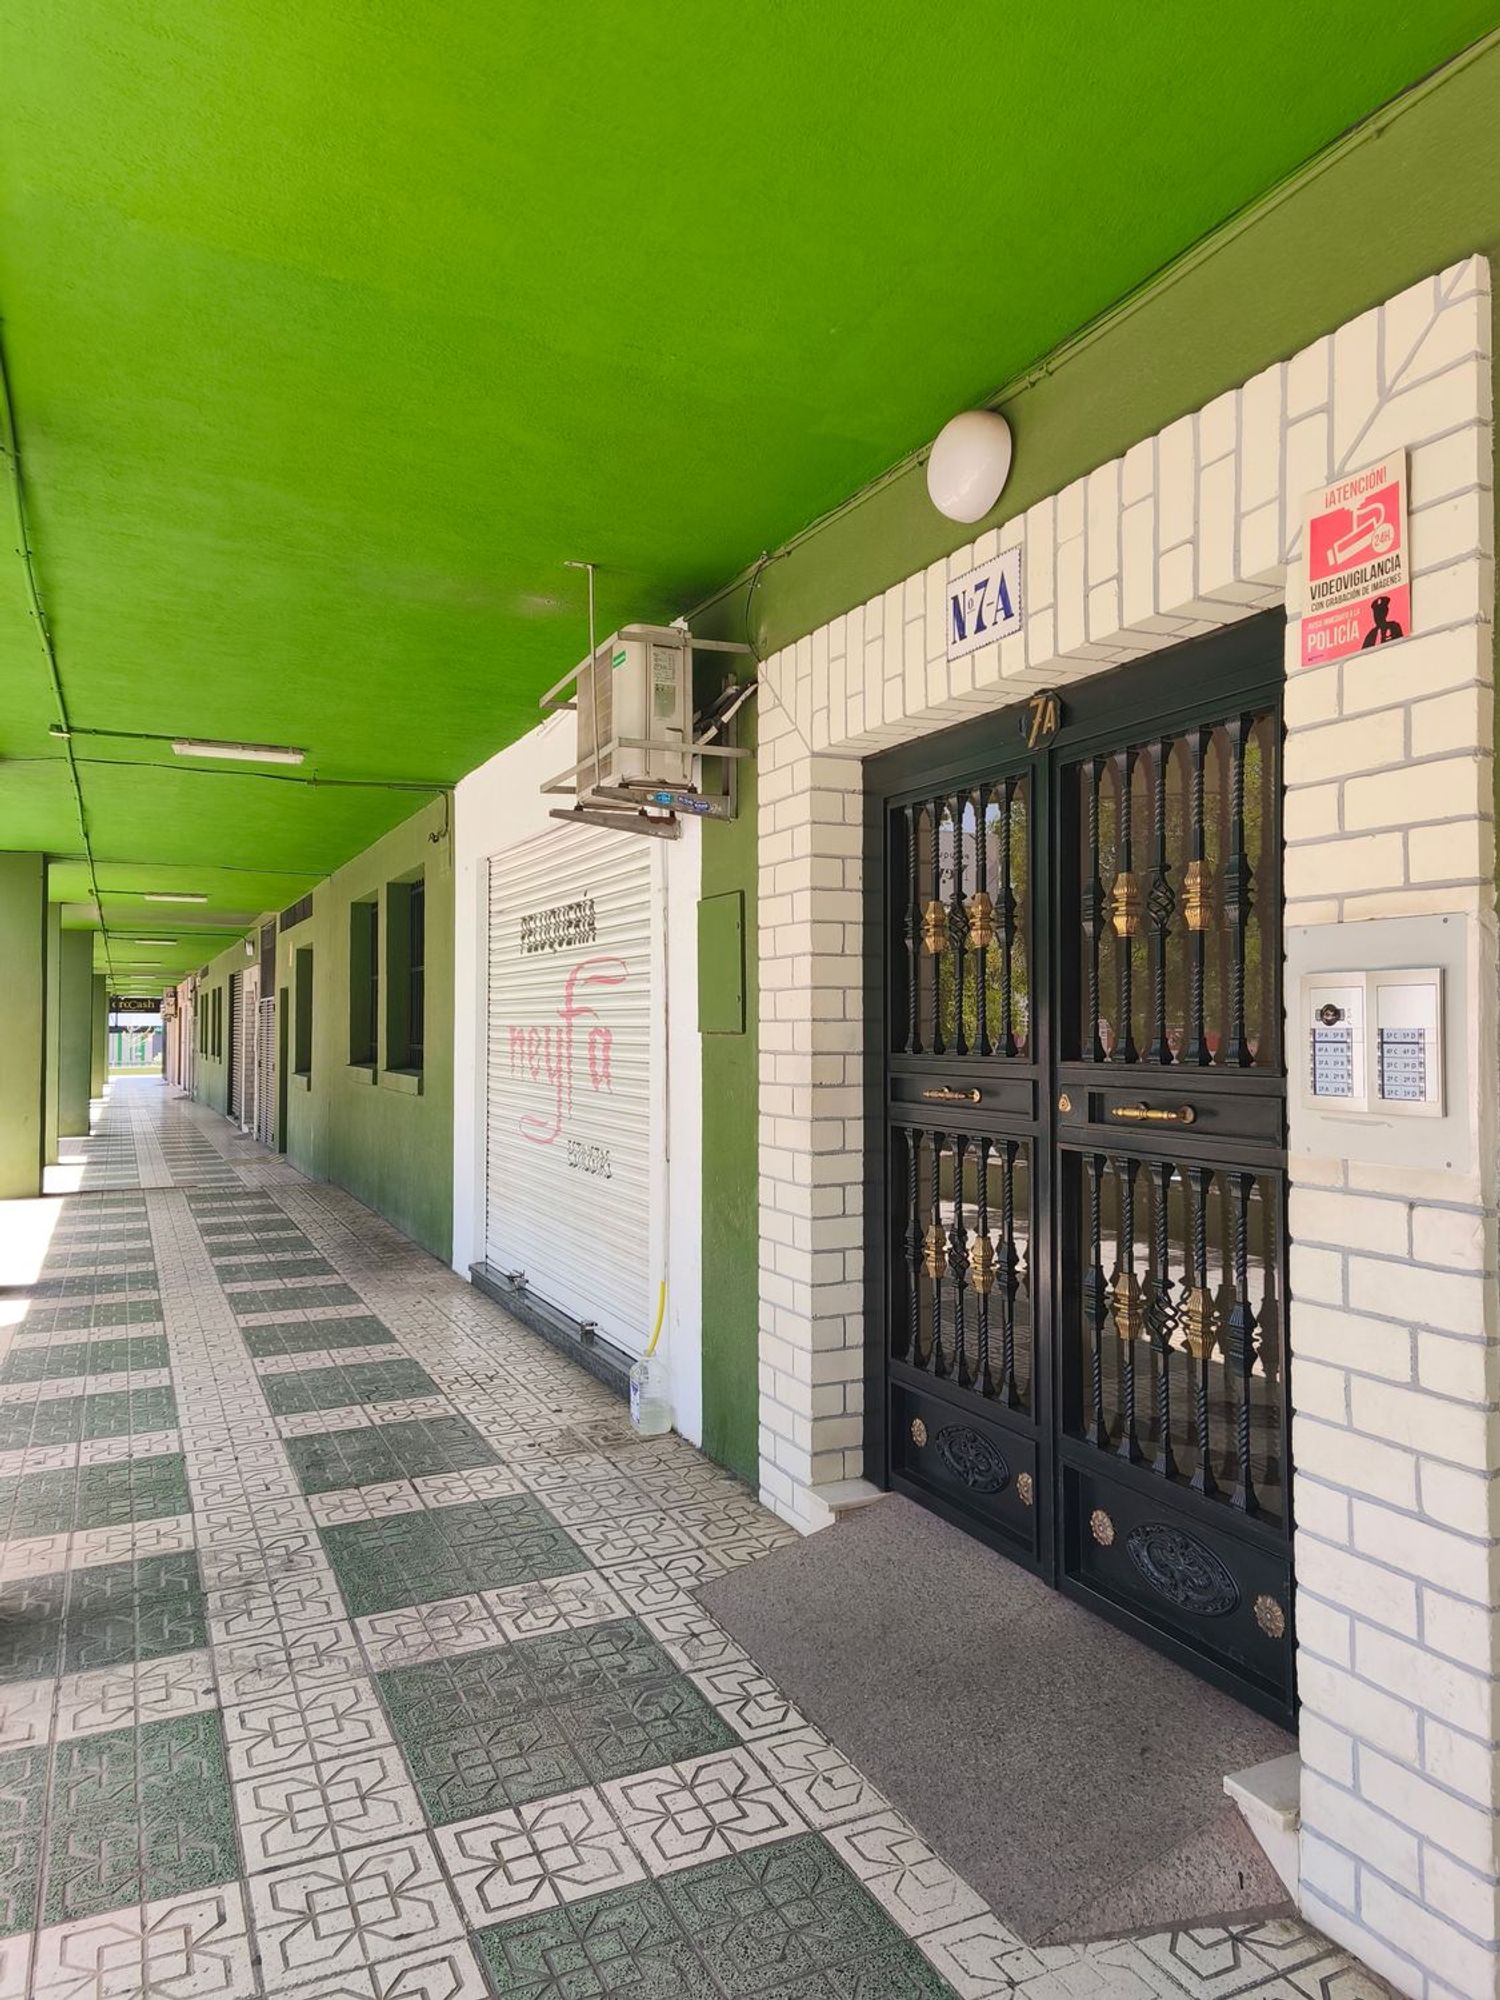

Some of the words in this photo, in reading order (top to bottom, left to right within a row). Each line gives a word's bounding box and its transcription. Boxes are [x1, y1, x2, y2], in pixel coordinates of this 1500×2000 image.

[1325, 466, 1387, 508] ¡ATENCIÓN!
[1310, 554, 1402, 601] VIDEOVIGILANCIA
[1310, 601, 1325, 613] CON
[1325, 587, 1361, 610] GRABACIÓN
[1361, 584, 1371, 598] DE
[1308, 618, 1361, 653] POLICÍA
[1028, 697, 1055, 749] 7A
